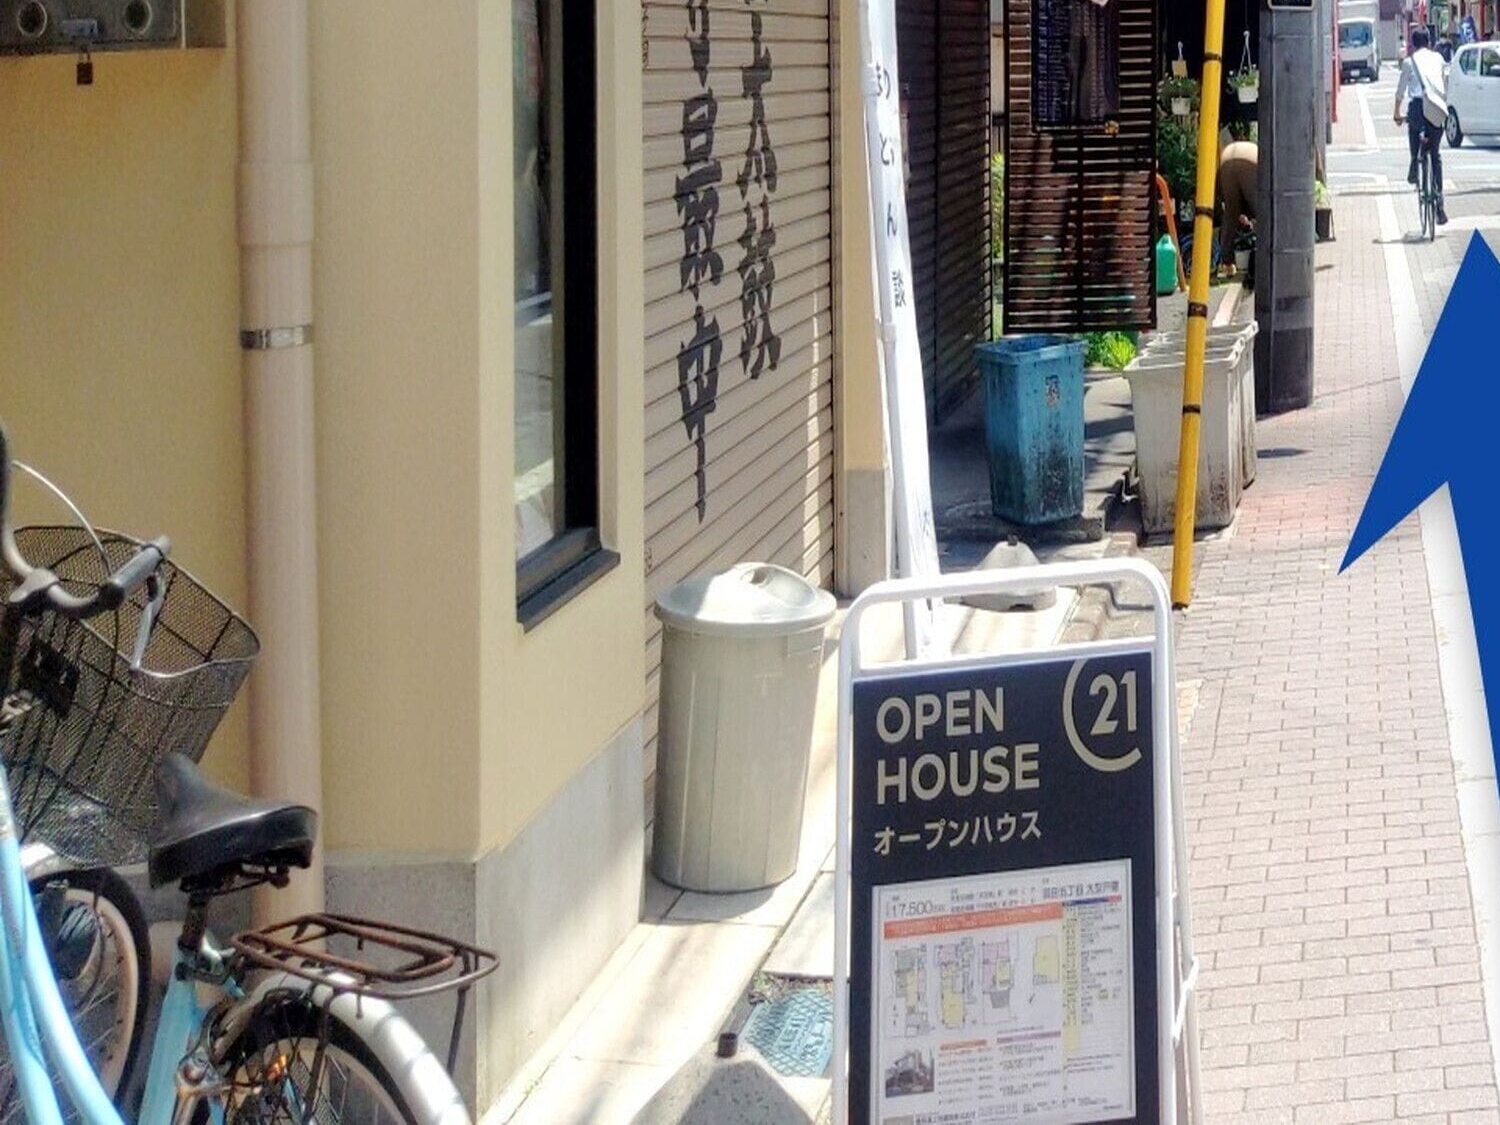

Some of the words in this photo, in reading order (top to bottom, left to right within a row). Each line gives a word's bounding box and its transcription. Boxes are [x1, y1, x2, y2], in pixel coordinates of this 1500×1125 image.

[876, 687, 1004, 744] OPEN
[877, 743, 1040, 805] HOUSE
[874, 811, 1041, 856] オープンハウス
